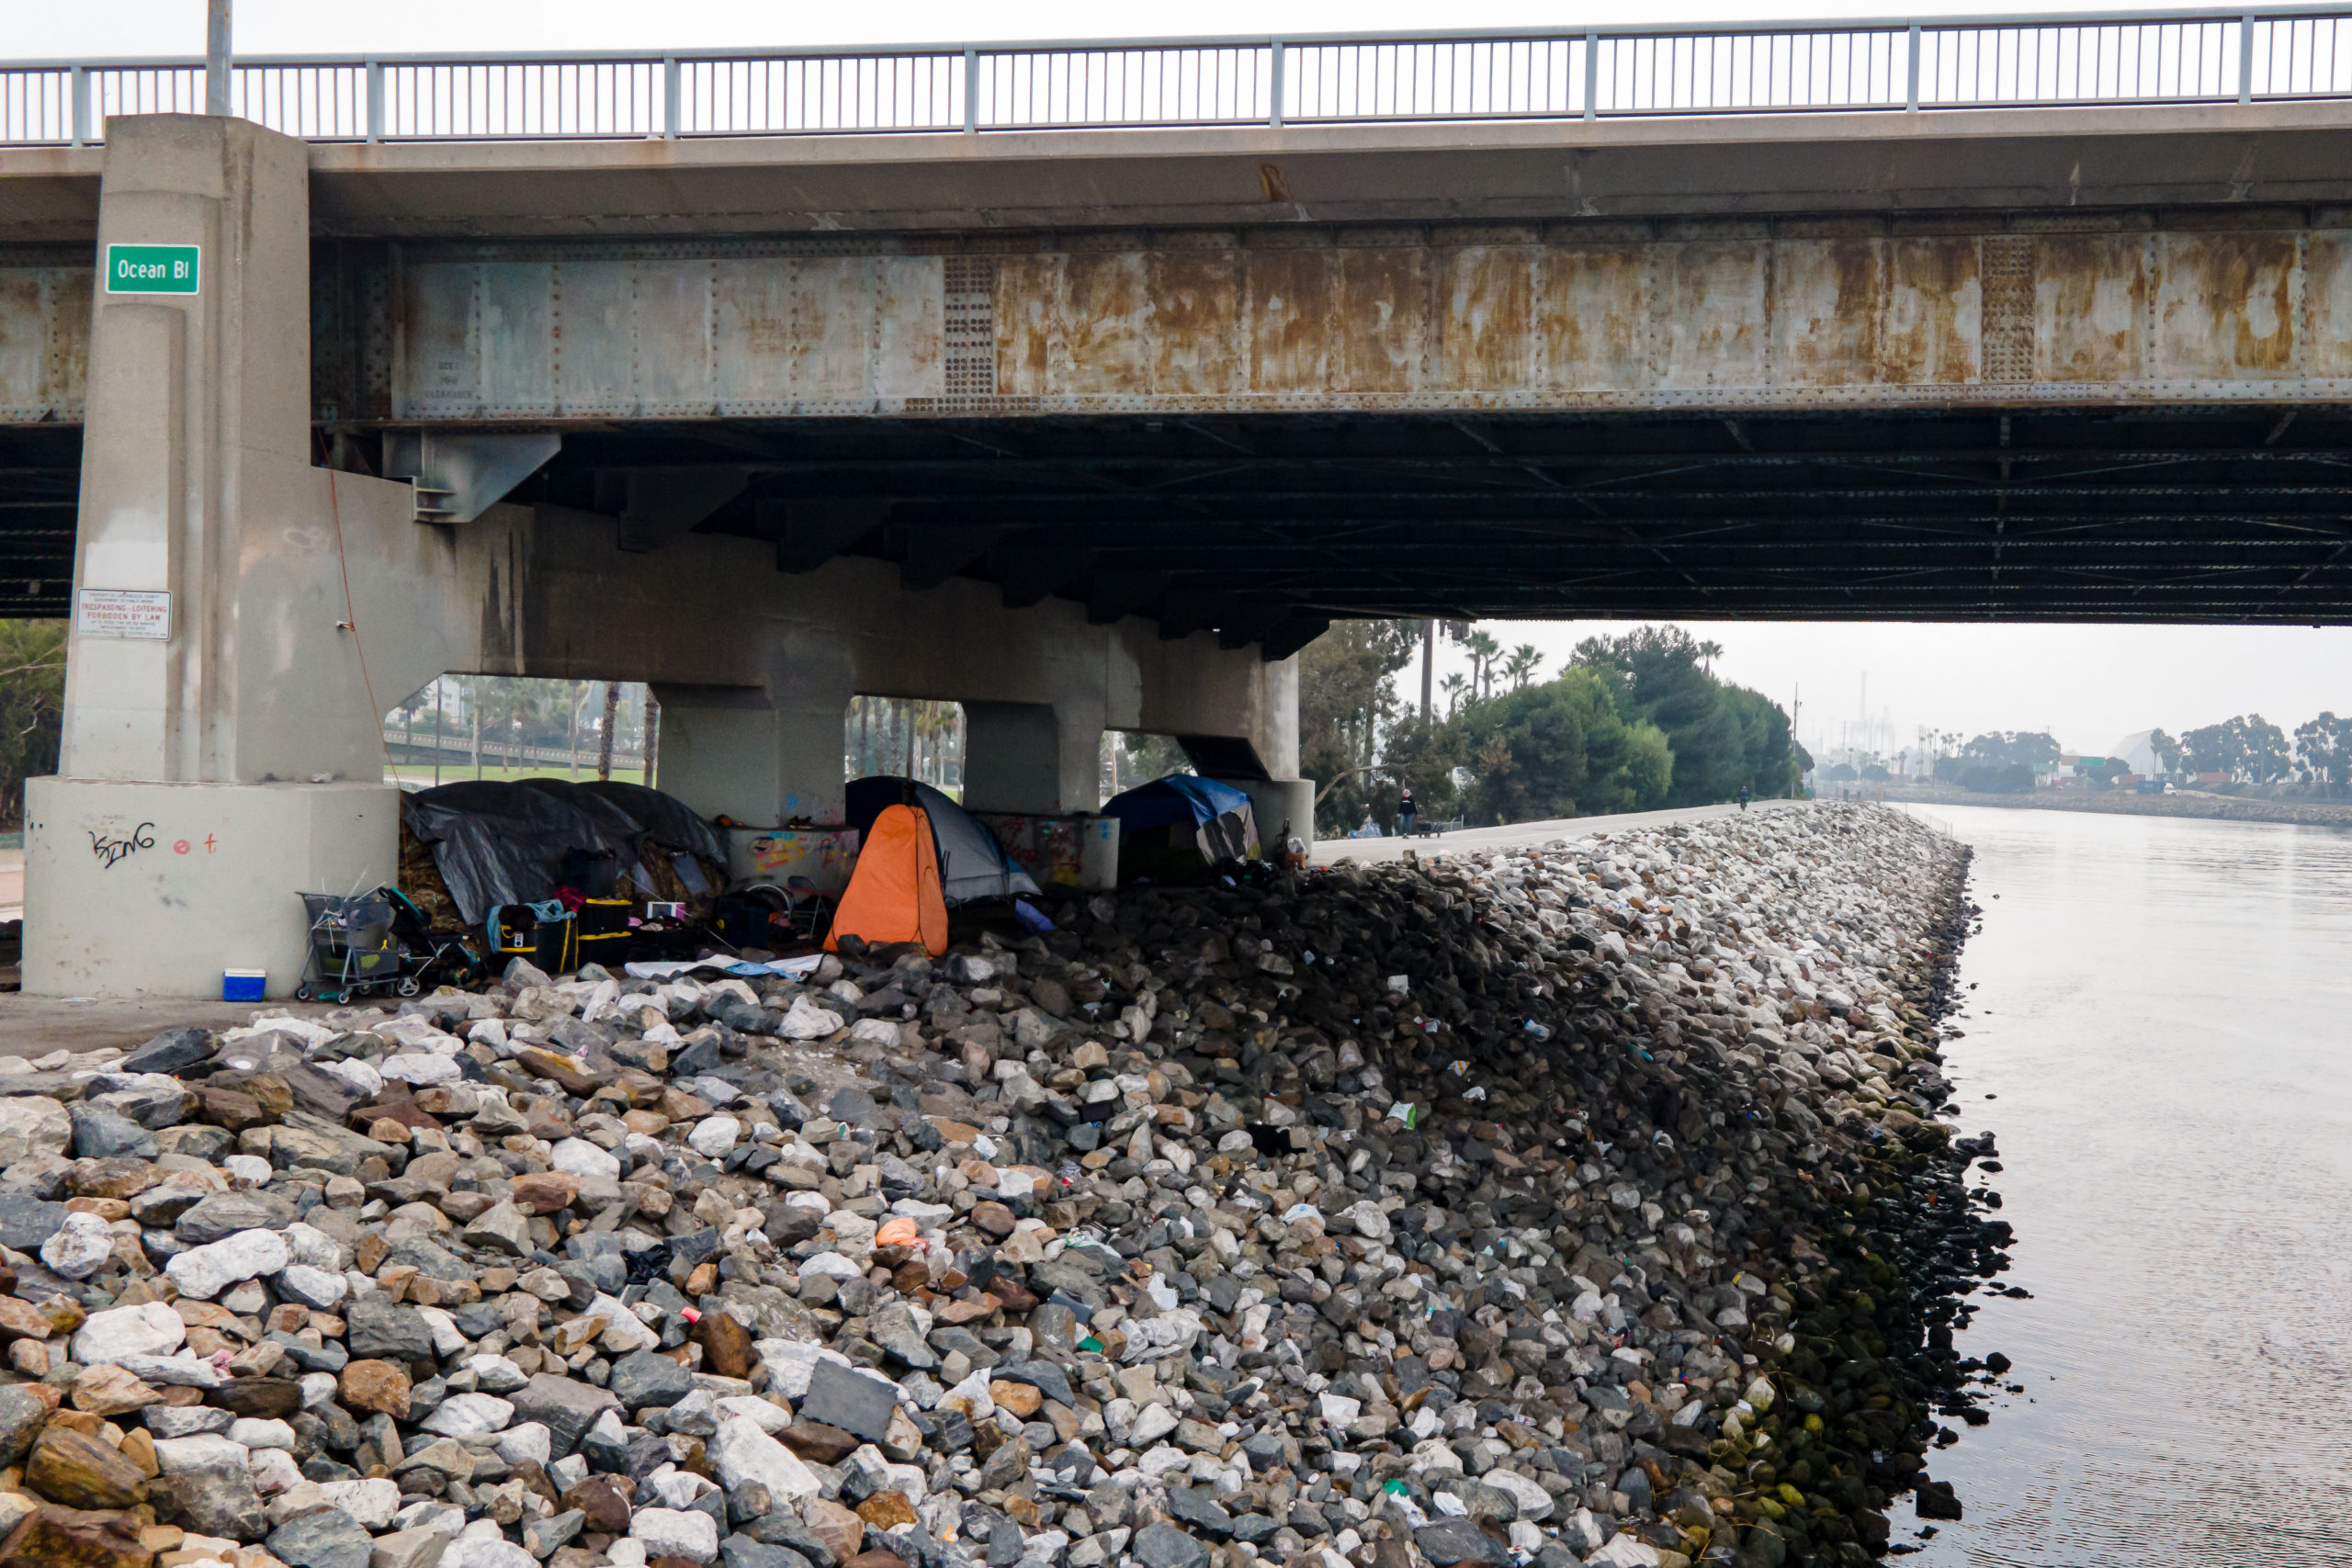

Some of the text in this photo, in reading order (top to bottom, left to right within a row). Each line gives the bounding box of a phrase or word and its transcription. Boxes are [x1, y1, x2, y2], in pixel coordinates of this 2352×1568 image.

[118, 259, 189, 279] Ocean Bl
[81, 603, 126, 612] TRESPASSING
[131, 604, 167, 614] LOITERING
[87, 612, 128, 620] FORBIDDEN
